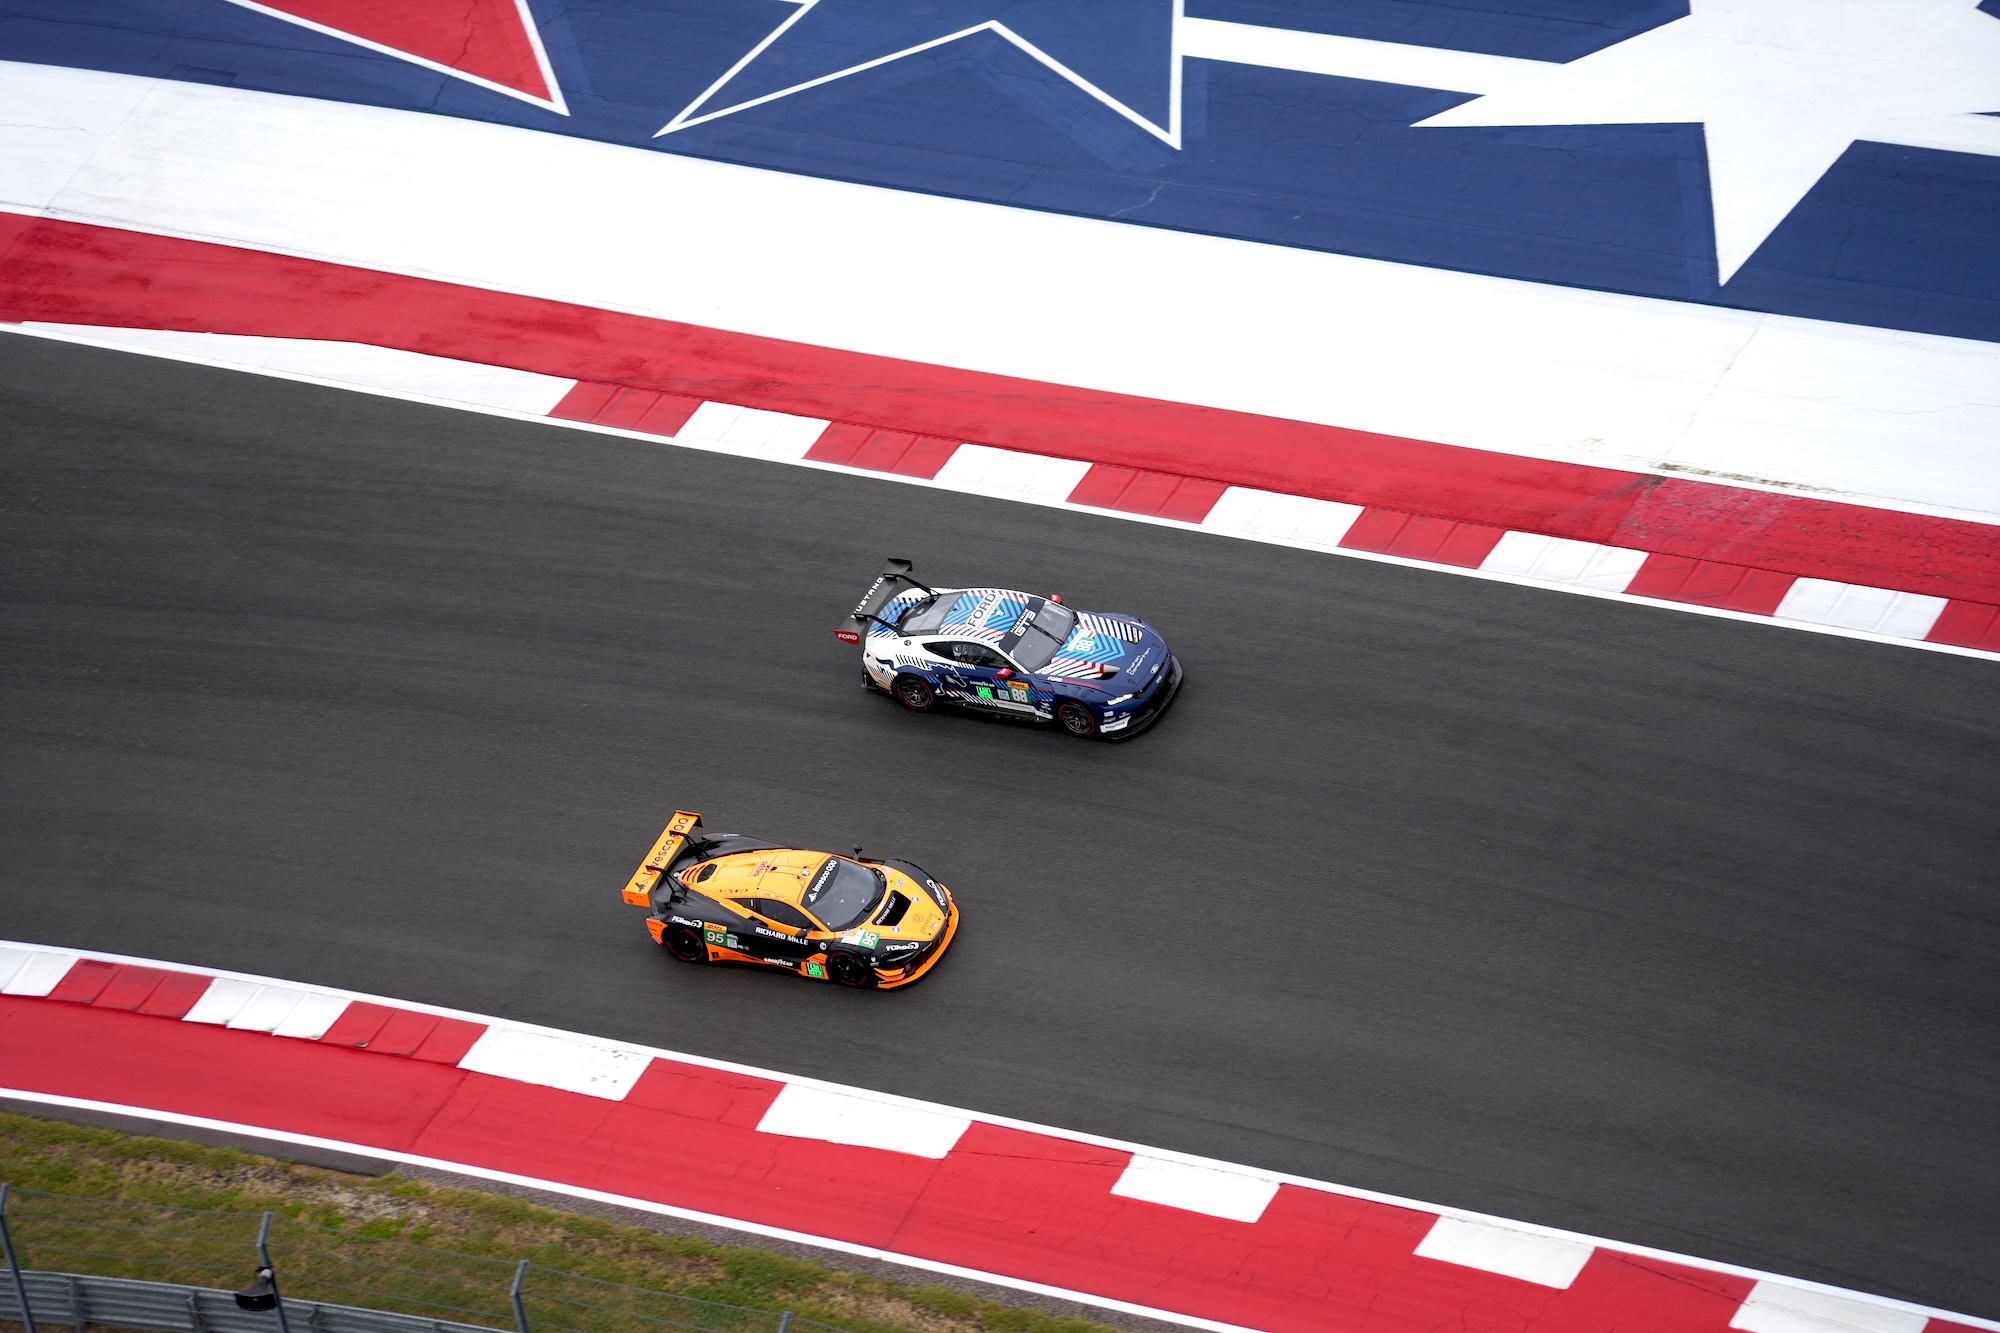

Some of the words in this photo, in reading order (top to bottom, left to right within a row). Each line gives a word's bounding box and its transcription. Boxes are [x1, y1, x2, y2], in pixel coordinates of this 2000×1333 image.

[967, 593, 996, 628] FORD
[1013, 610, 1037, 637] GT3
[837, 633, 858, 641] FORD
[1075, 640, 1096, 652] 88
[1011, 688, 1029, 703] 88
[812, 870, 831, 893] Invesco
[707, 923, 724, 931] DHL
[755, 926, 786, 940] RICHARD
[707, 931, 724, 943] 95
[862, 932, 877, 947] 95
[763, 957, 794, 967] GOODYEAR
